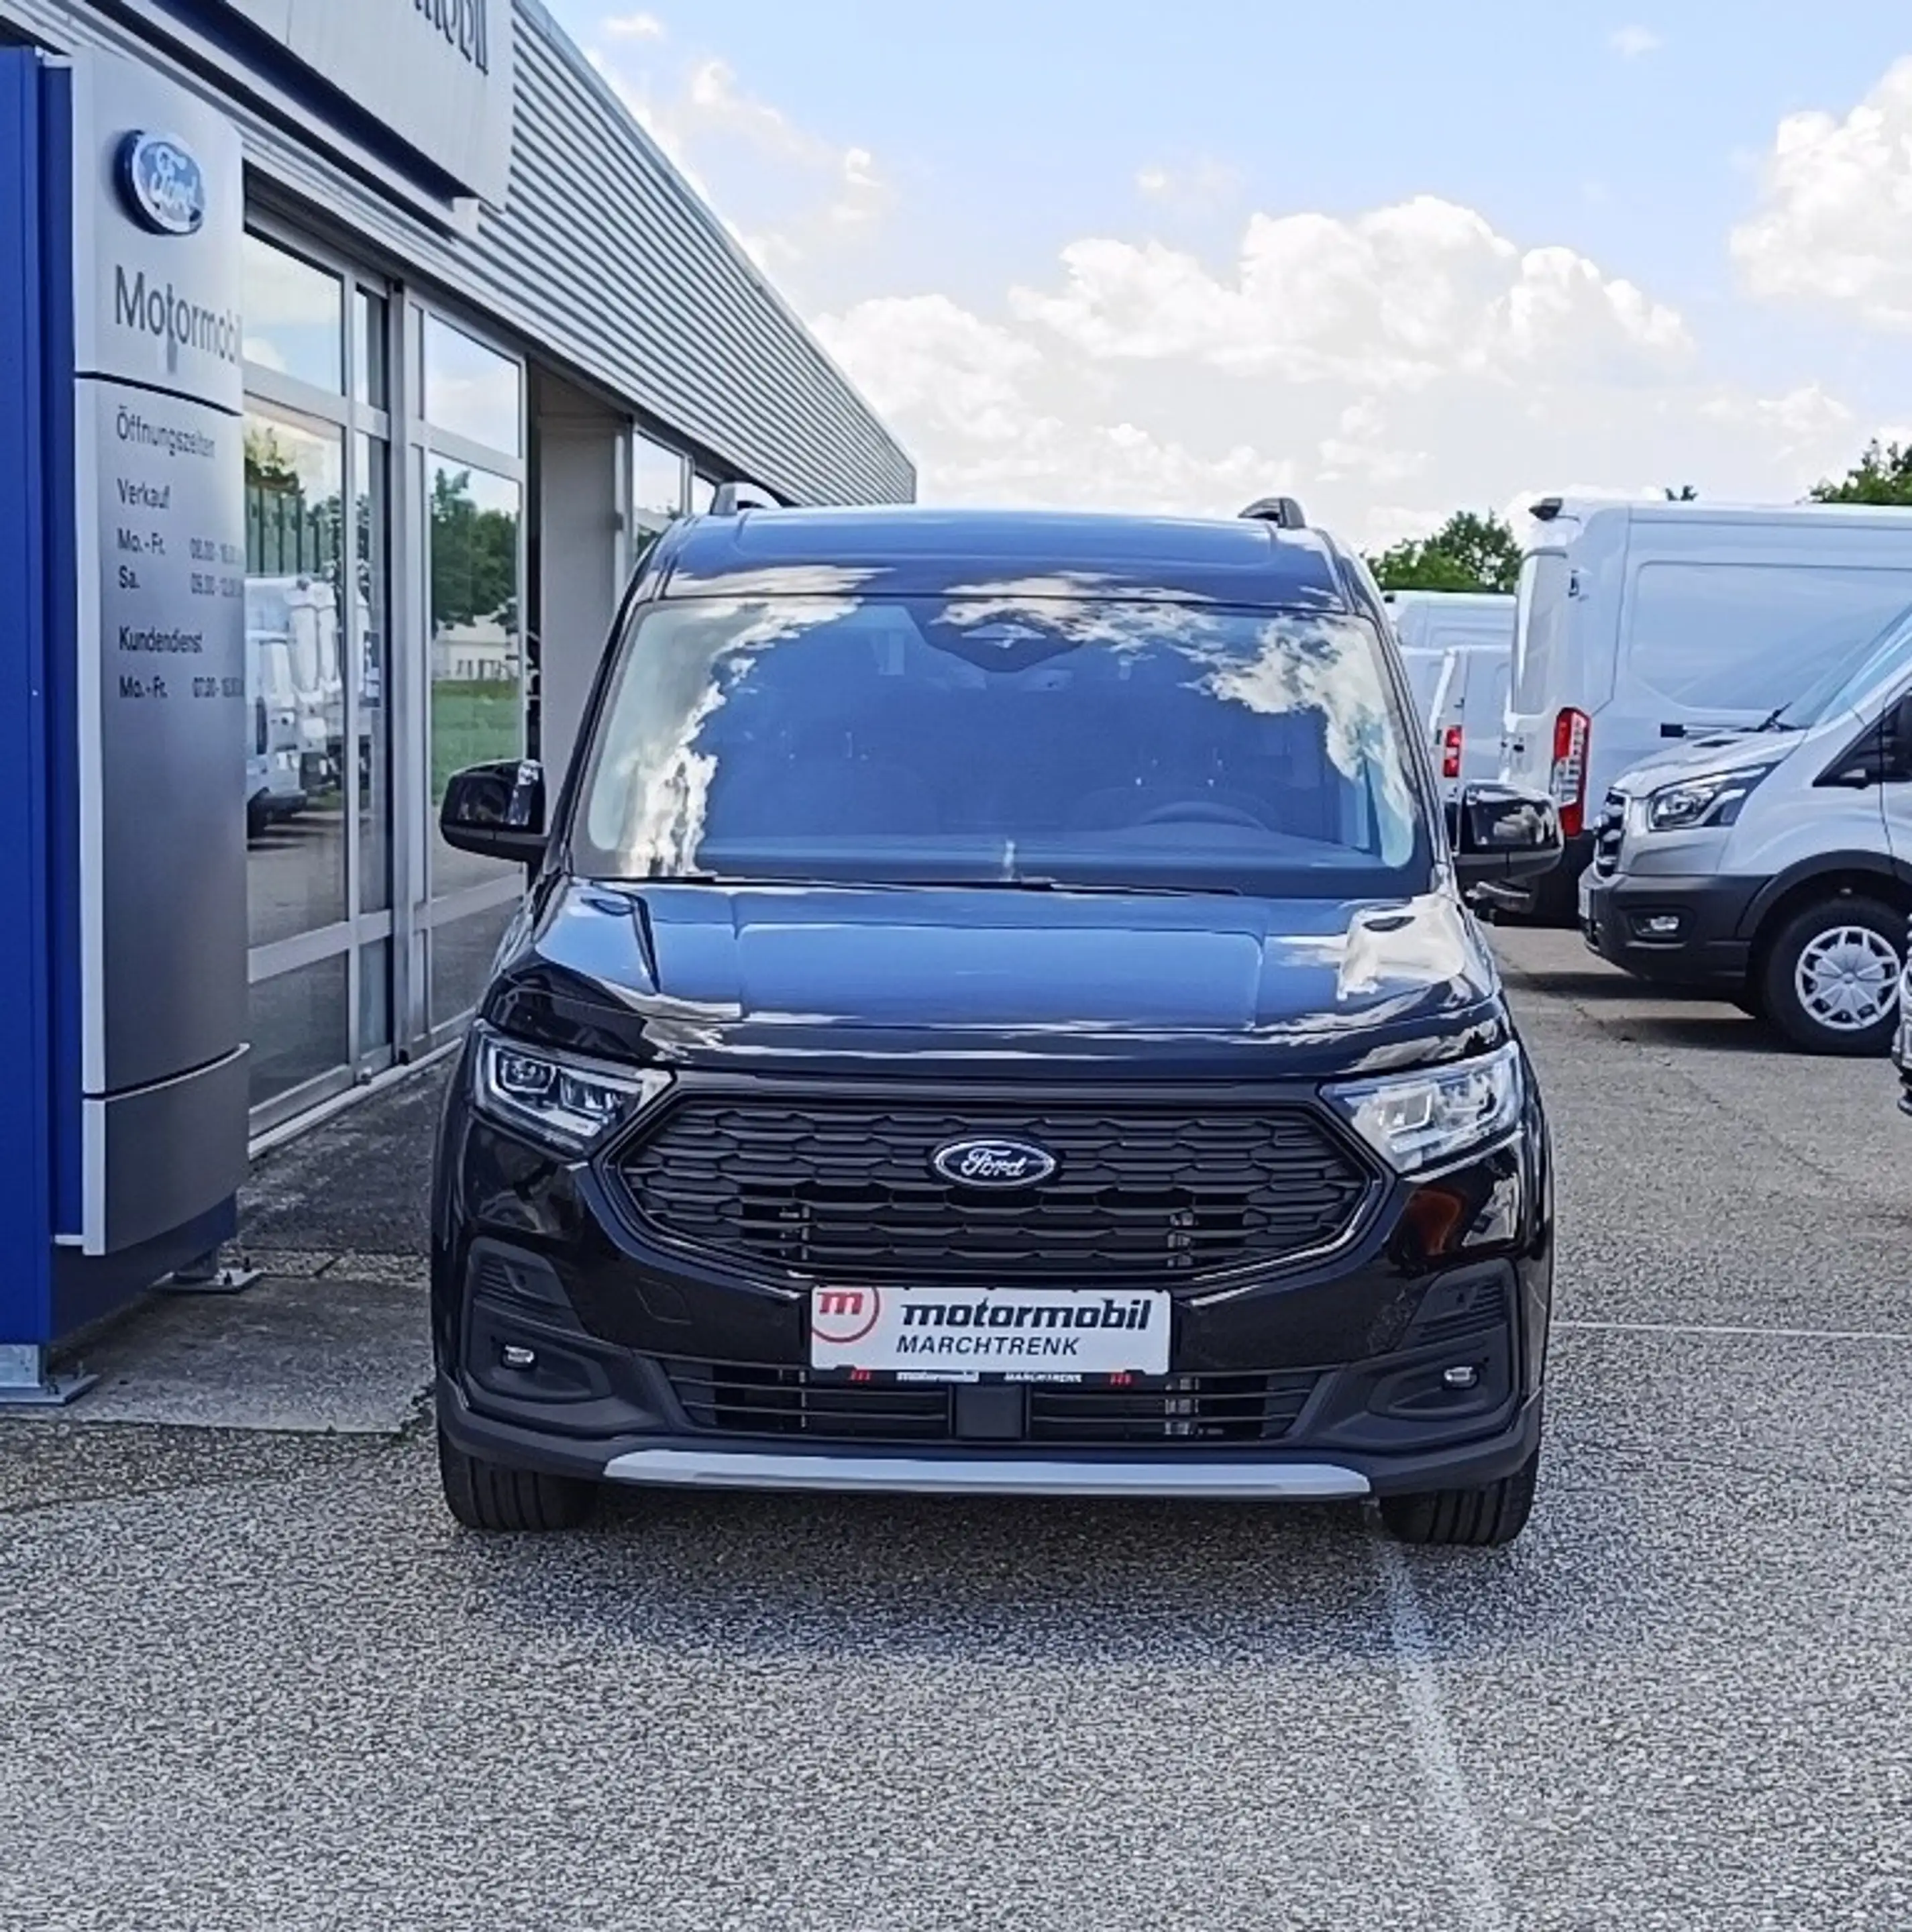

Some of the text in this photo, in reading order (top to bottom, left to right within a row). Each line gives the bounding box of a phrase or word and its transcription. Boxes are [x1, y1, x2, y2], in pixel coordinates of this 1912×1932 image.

[150, 145, 197, 210] Ford
[115, 264, 241, 364] Motormobi
[117, 478, 170, 509] Verkauf
[961, 1148, 1027, 1176] Ford
[817, 1292, 1152, 1330] m motormobil
[896, 1334, 1080, 1356] MARCHTRENK
